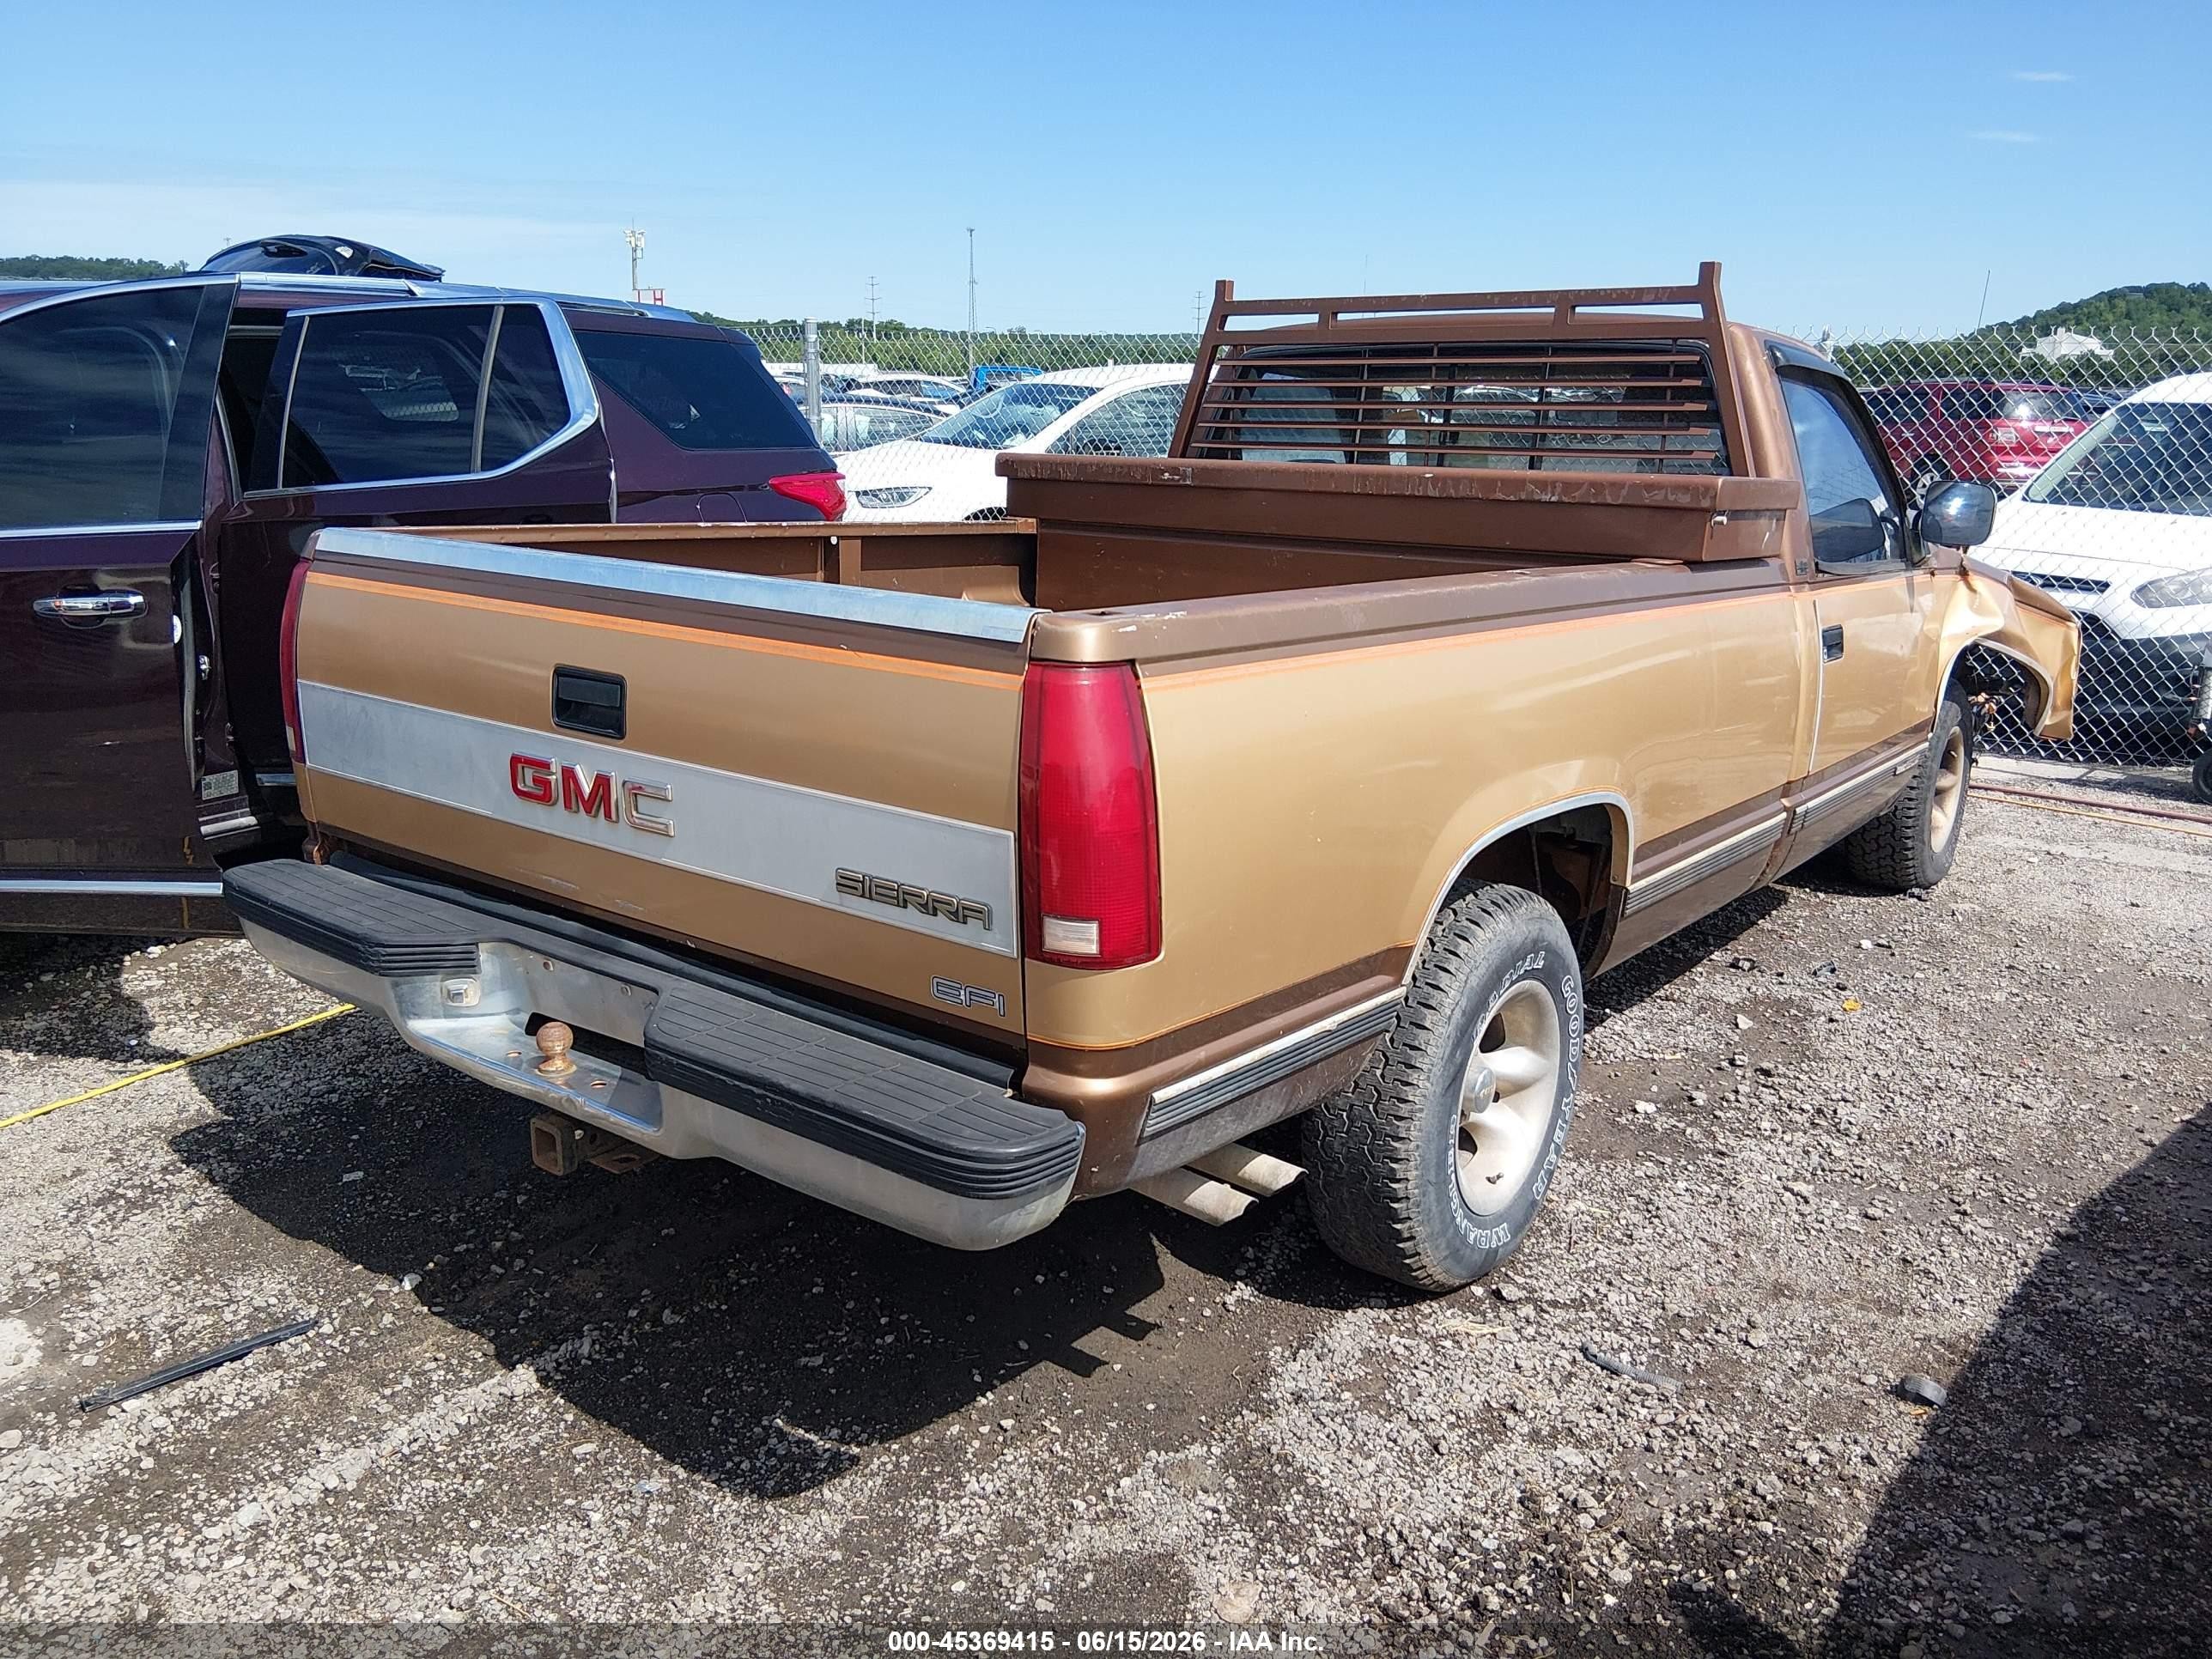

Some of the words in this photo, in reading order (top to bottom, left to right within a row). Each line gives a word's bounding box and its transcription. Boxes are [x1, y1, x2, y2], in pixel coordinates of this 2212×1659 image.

[509, 751, 675, 837] GMC
[836, 867, 993, 931] SIERRA
[932, 975, 1006, 1017] EFI
[1472, 951, 1545, 1042] RADIAL
[1533, 975, 1580, 1200] GOODYEAR
[1447, 1115, 1510, 1249] WRANGLER
